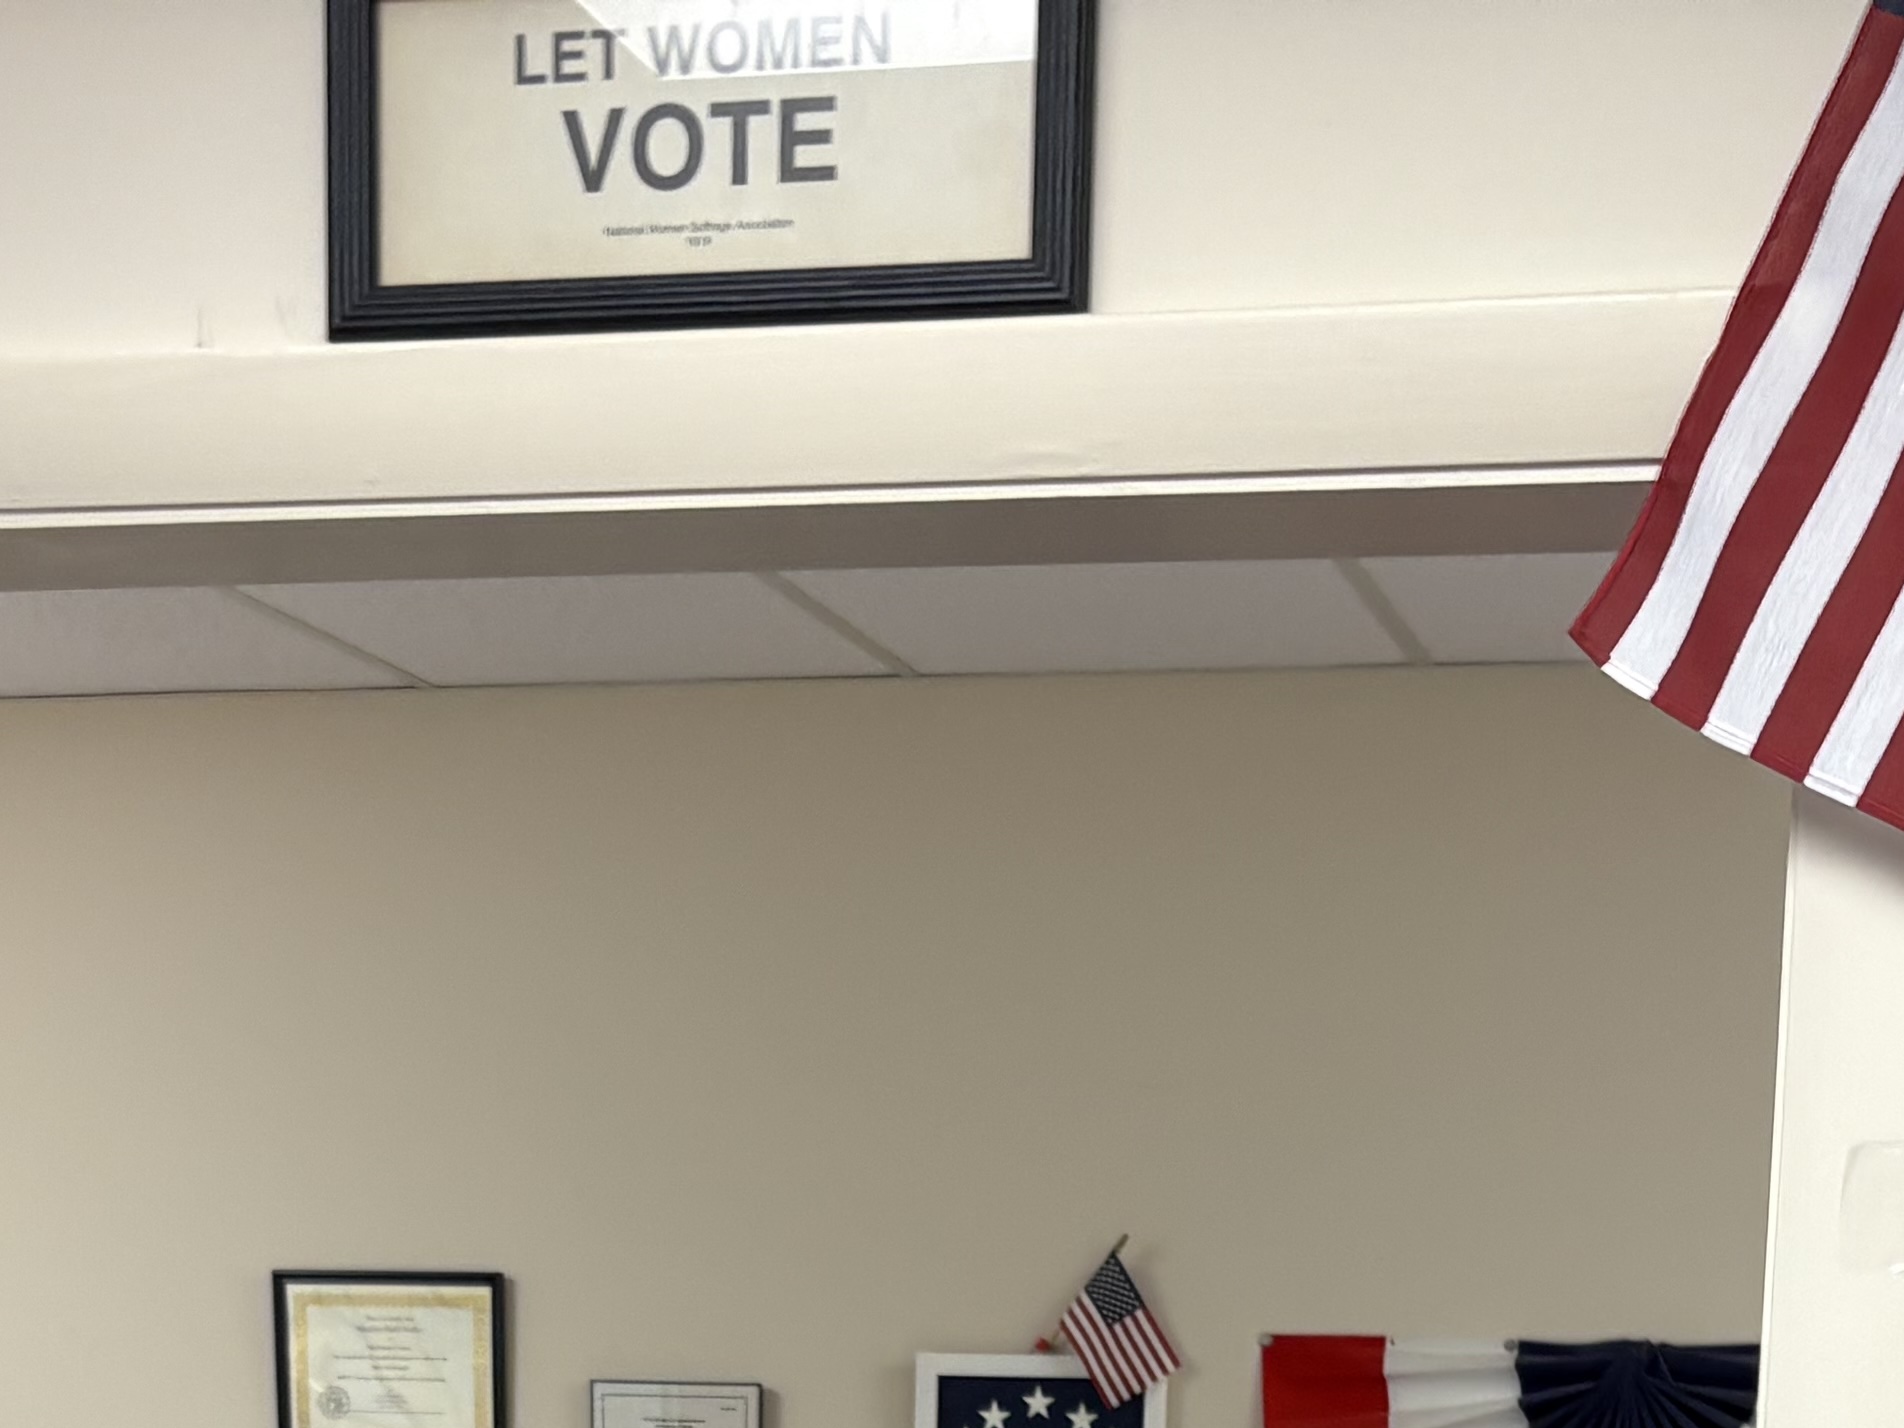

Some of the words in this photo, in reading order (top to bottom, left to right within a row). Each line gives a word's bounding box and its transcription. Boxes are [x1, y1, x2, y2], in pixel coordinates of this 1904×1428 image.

[514, 28, 622, 87] LET
[649, 9, 892, 77] WOMEN
[561, 96, 839, 194] VOTE
